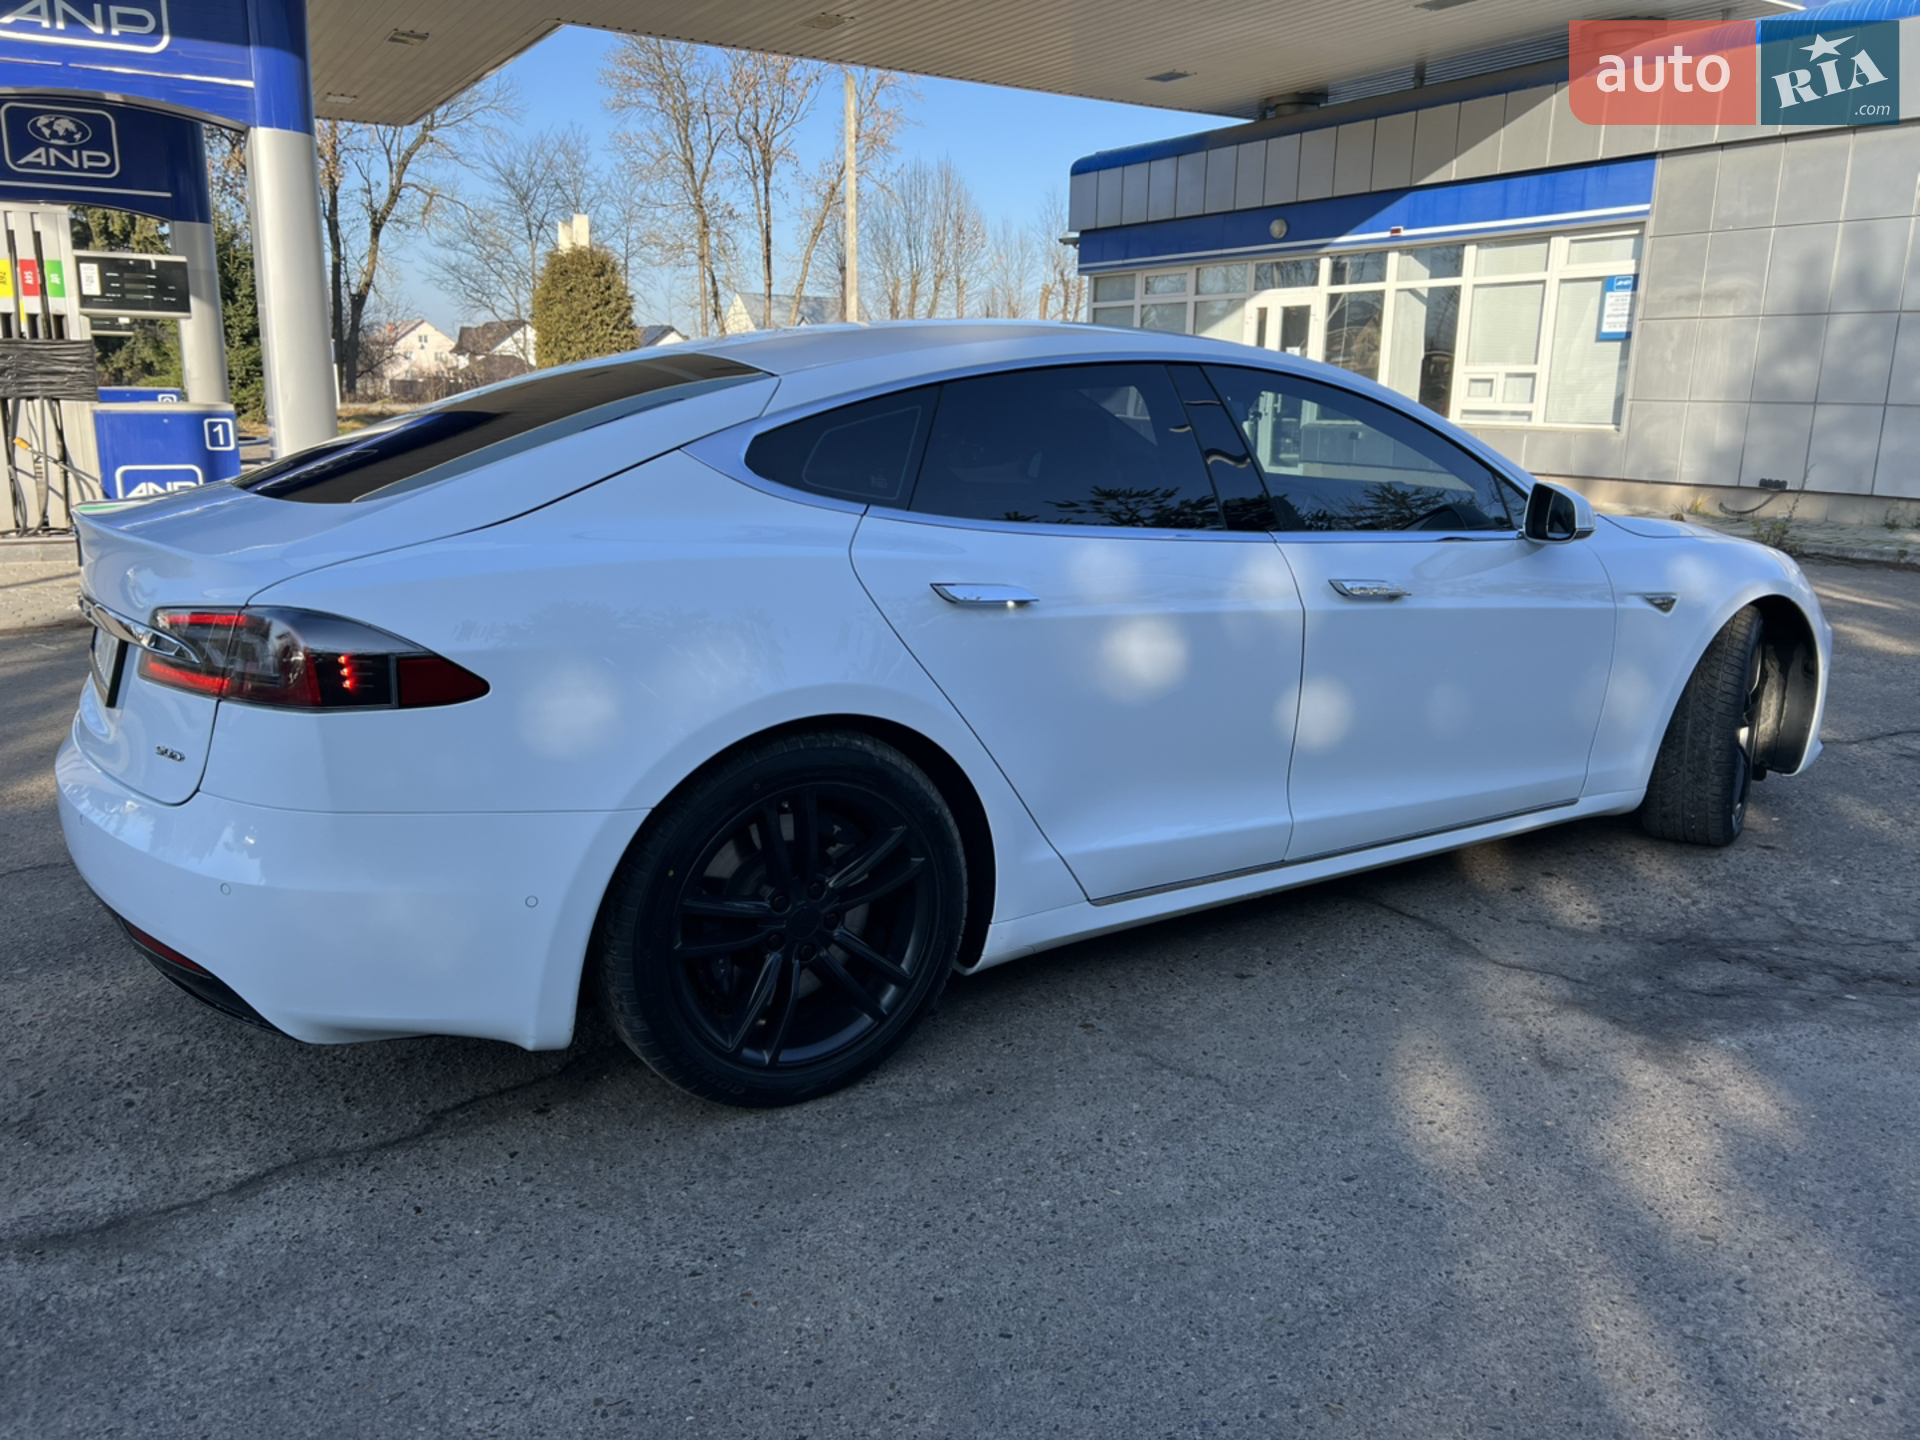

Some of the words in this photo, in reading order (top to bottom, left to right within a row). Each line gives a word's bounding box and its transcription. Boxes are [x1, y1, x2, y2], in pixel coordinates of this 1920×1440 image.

[0, 0, 157, 36] ANP
[16, 147, 111, 169] ANP
[213, 424, 225, 446] 1
